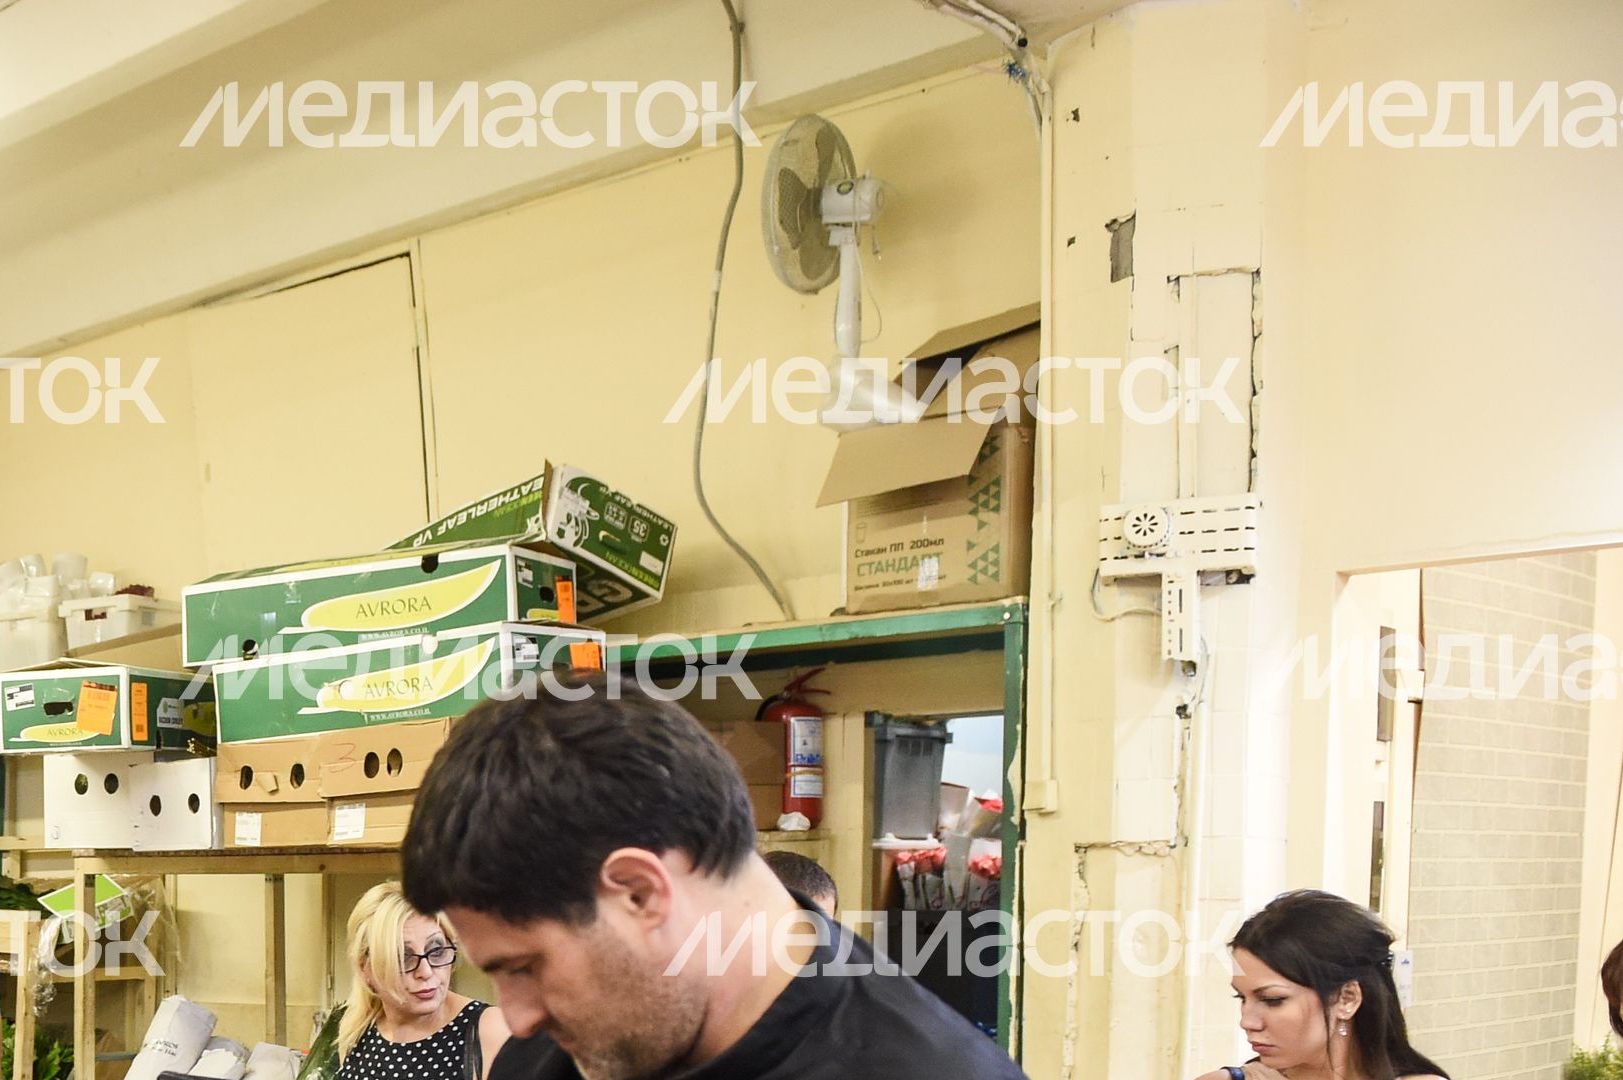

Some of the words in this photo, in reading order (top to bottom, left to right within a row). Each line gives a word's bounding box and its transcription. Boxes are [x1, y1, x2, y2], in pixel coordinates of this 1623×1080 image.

[436, 476, 545, 537] EATHERLEAF
[854, 546, 888, 558] Стакан
[889, 541, 905, 552] ПП
[909, 537, 945, 551] 200мл
[355, 596, 433, 619] AVRORA
[363, 676, 434, 699] AVRORA
[47, 727, 84, 737] AVRORA
